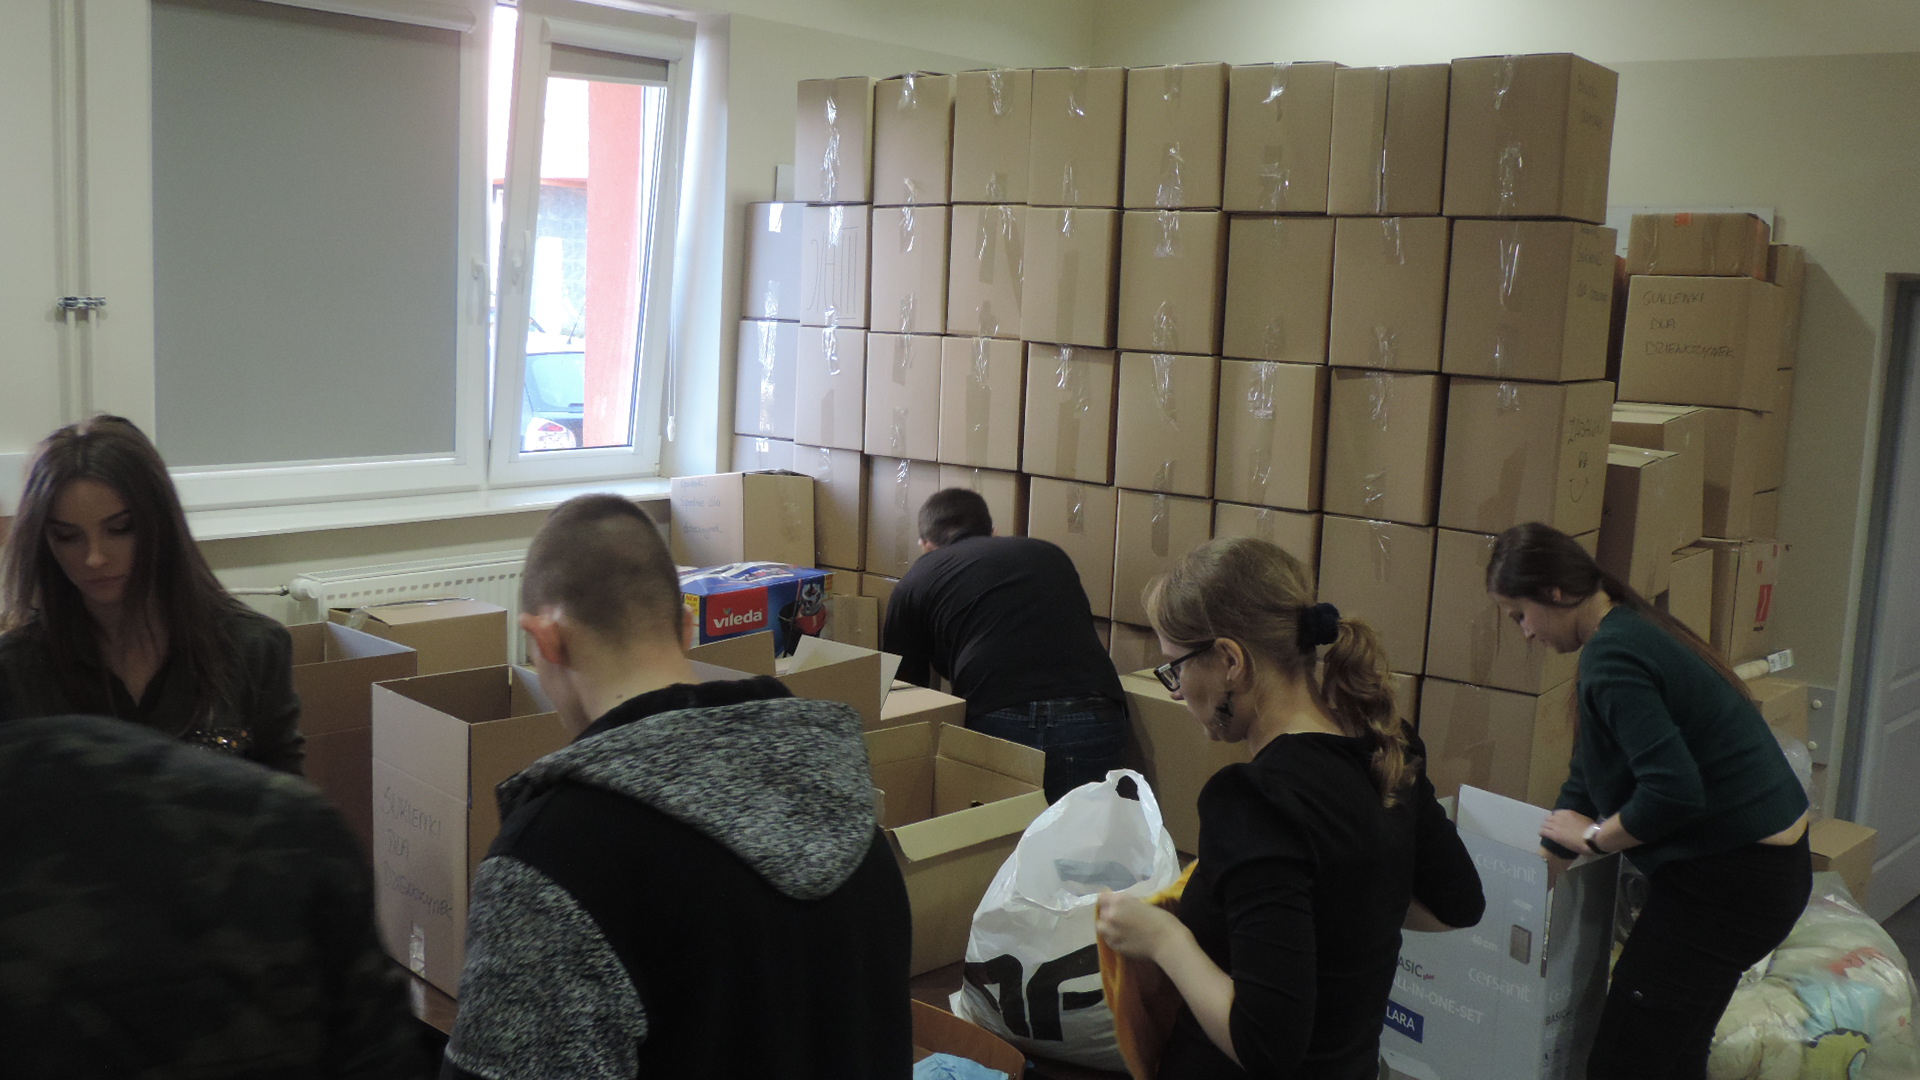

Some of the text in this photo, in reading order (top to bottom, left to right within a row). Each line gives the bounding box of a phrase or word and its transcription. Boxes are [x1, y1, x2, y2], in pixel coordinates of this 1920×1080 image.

[1650, 317, 1676, 331] DLA
[713, 608, 763, 629] vileda
[388, 829, 410, 858] DLA
[1475, 853, 1537, 885] cersanit
[1398, 956, 1423, 978] ASIC
[1468, 967, 1531, 1003] cersanit
[1394, 975, 1484, 1025] LL-IN-ONE-SET
[1386, 1005, 1415, 1031] LARA
